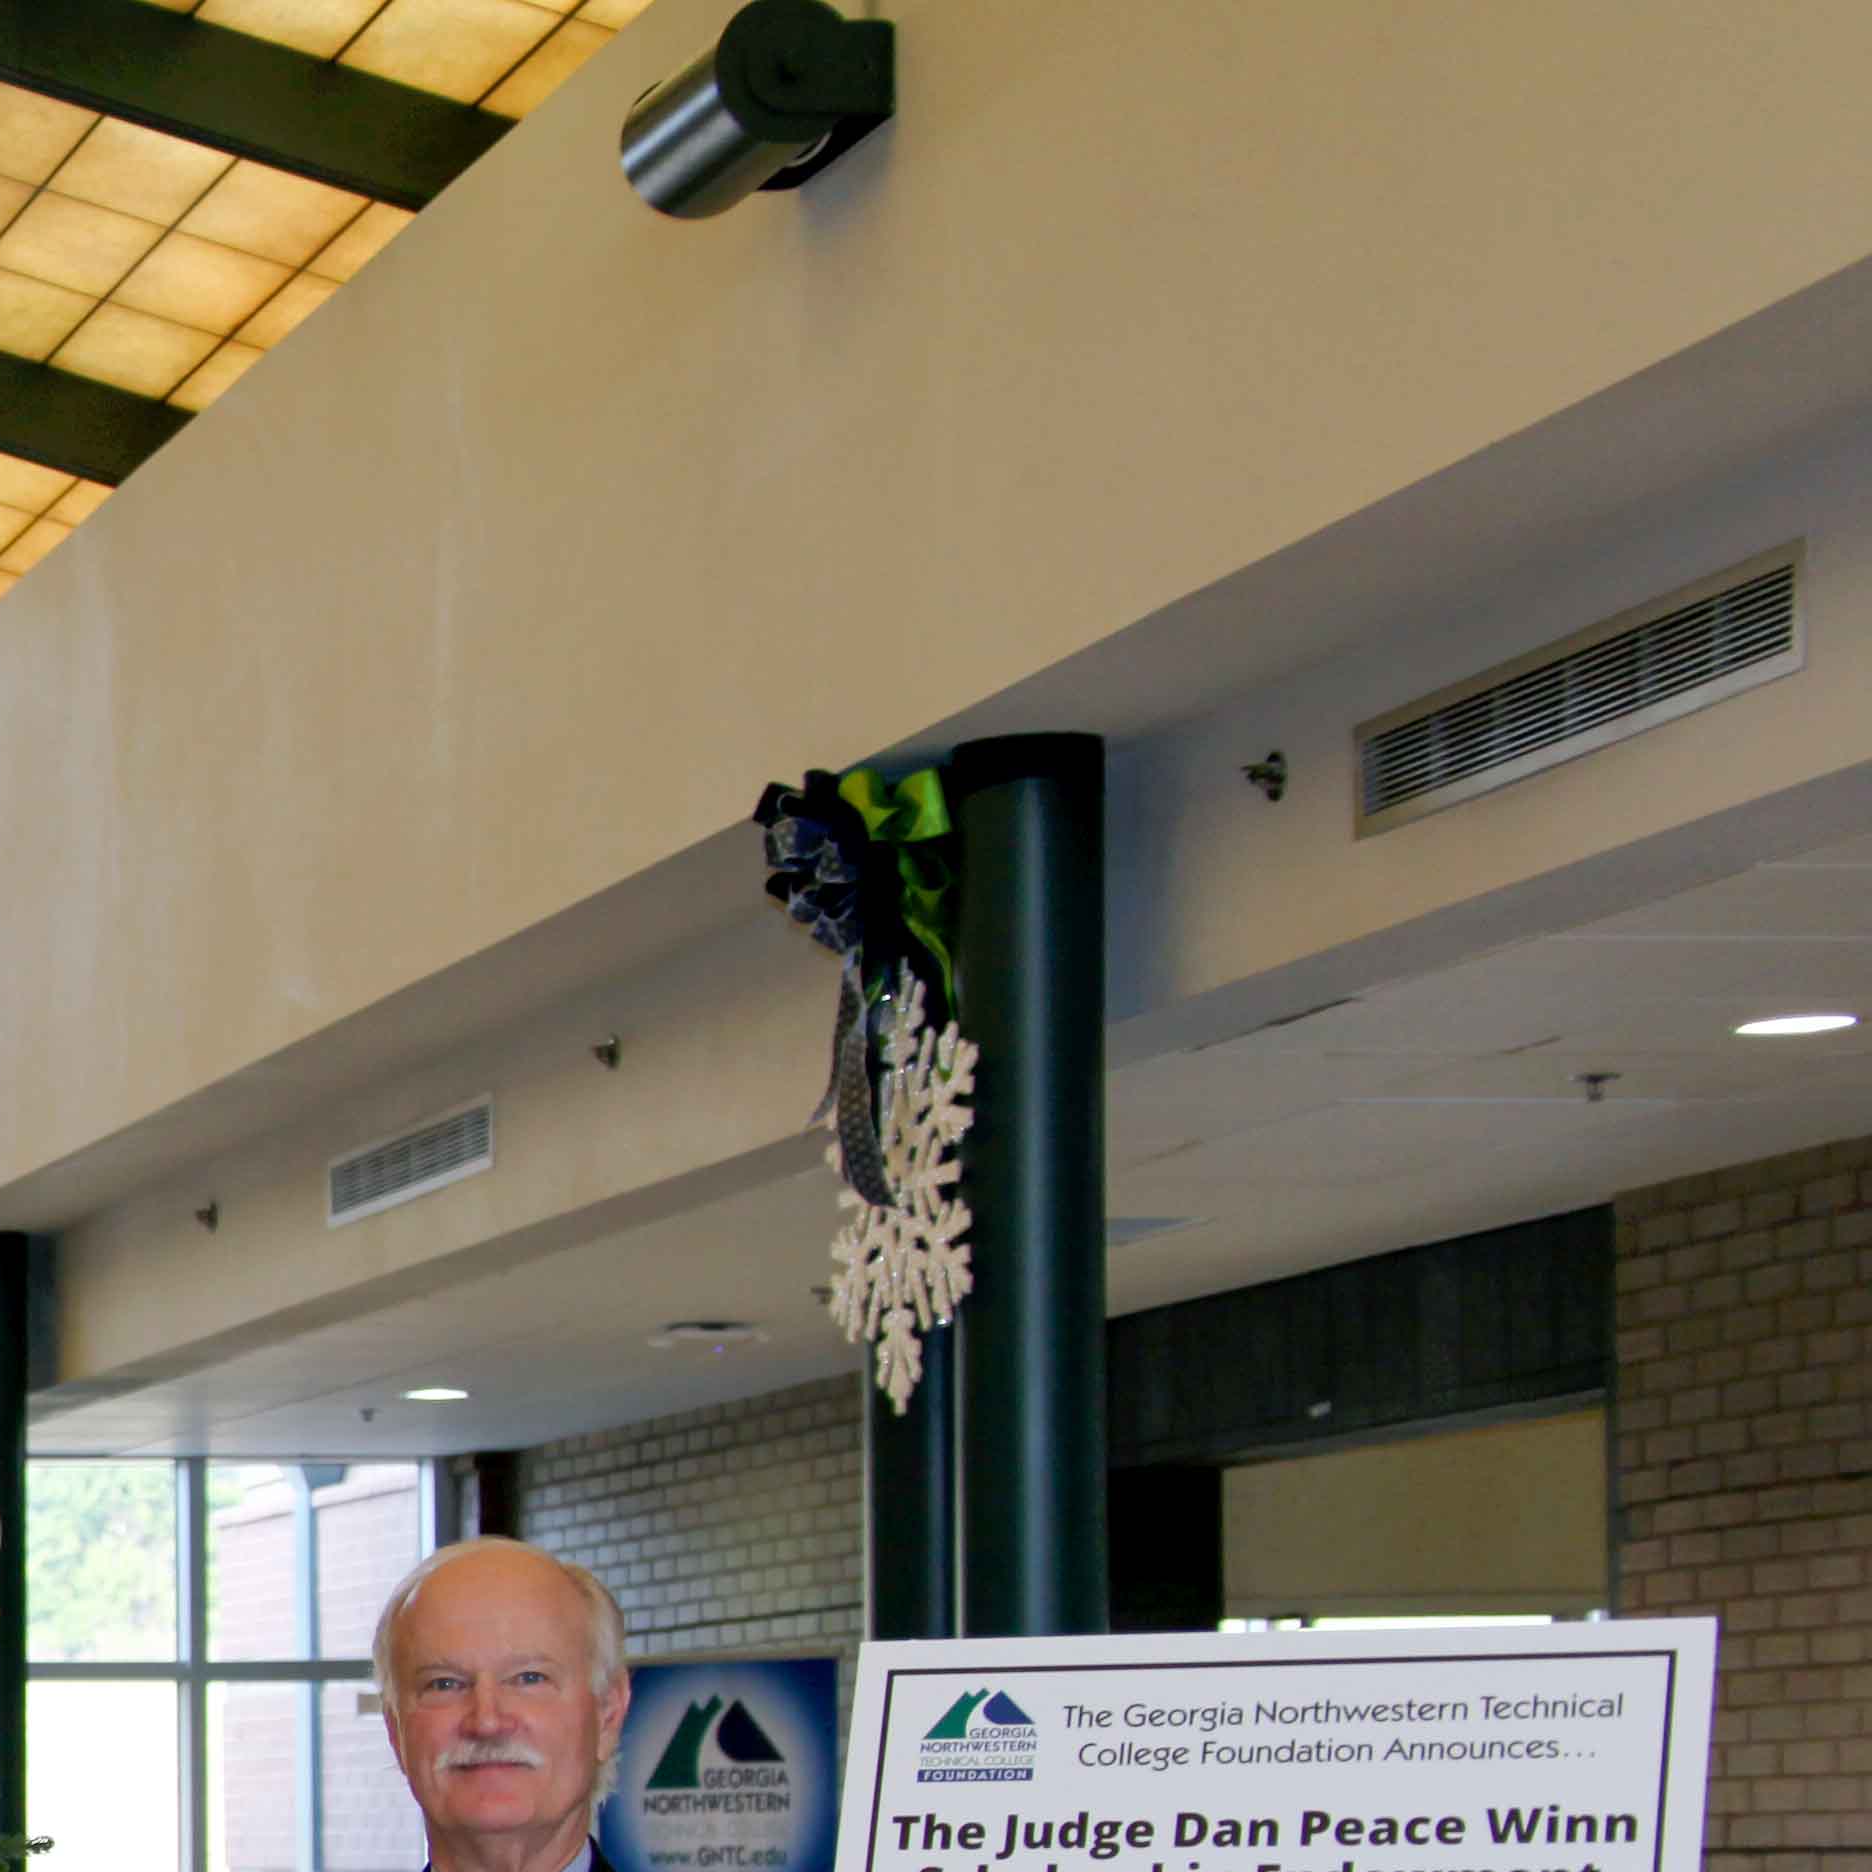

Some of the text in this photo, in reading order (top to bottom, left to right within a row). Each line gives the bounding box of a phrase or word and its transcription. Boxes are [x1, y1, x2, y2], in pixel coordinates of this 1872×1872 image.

[1063, 1693, 1624, 1732] The Georgia Northwestern Technical
[969, 1727, 1037, 1740] GEORGIA
[919, 1740, 1037, 1754] NORTHWESTERN
[1078, 1741, 1190, 1772] College
[1201, 1738, 1373, 1765] Foundation
[703, 1767, 789, 1791] GEORGIA
[923, 1769, 1028, 1781] FOUNDATION
[643, 1792, 791, 1816] NORTHWESTERN
[892, 1804, 1639, 1860] The Judge Dan Peace Winn
